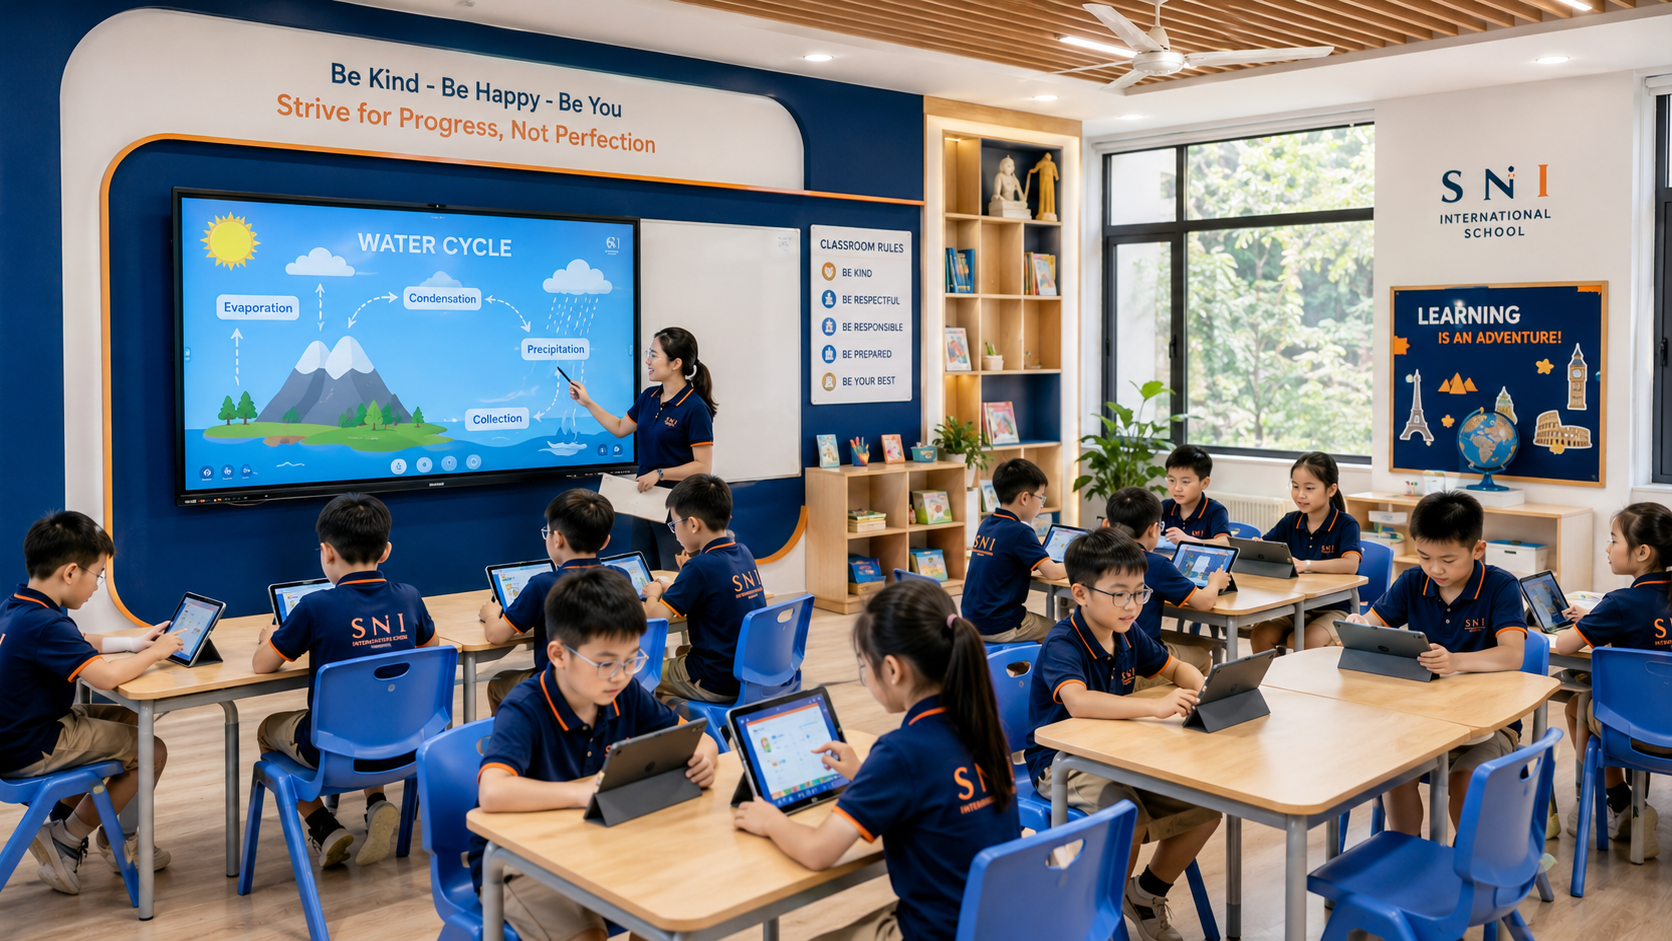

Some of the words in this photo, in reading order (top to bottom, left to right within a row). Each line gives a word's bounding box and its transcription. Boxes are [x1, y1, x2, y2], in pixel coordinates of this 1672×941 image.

[331, 62, 361, 86] Be
[369, 67, 419, 93] Kind
[441, 77, 469, 99] Be
[475, 81, 540, 112] Happy
[559, 91, 583, 112] Be
[588, 96, 622, 118] You
[277, 93, 350, 123] Strive
[358, 102, 392, 126] for
[399, 107, 504, 141] Progress,
[511, 120, 549, 143] Not
[555, 125, 656, 154] Perfection
[1440, 208, 1551, 224] INTERNATIONAL
[1464, 226, 1525, 239] SCHOOL
[357, 232, 436, 255] WATER
[442, 236, 512, 257] CYCLE
[820, 238, 875, 251] CLASSROOM
[877, 242, 904, 254] RULES
[842, 268, 852, 277] BE
[854, 268, 873, 278] KIND
[409, 292, 477, 304] Condensation
[842, 295, 852, 304] BE
[854, 295, 900, 305] RESPECTFUL
[224, 301, 293, 316] Evaporation
[1418, 305, 1521, 325] LEARNING
[842, 322, 852, 332] BE
[854, 322, 903, 332] RESPONSIBLE
[1438, 331, 1450, 344] IS
[1453, 331, 1472, 344] AN
[1476, 330, 1562, 344] ADVENTURE!
[527, 344, 585, 356] Precipitation
[842, 350, 852, 359] BE
[854, 349, 893, 359] PREPARED
[842, 377, 852, 386] BE
[854, 376, 876, 386] YOUR
[877, 375, 896, 385] BEST
[472, 413, 523, 425] Collection
[973, 534, 996, 551] SNI
[731, 569, 762, 592] SNI
[351, 613, 407, 639] SNI
[1465, 617, 1485, 627] SNI
[1653, 617, 1672, 639] S
